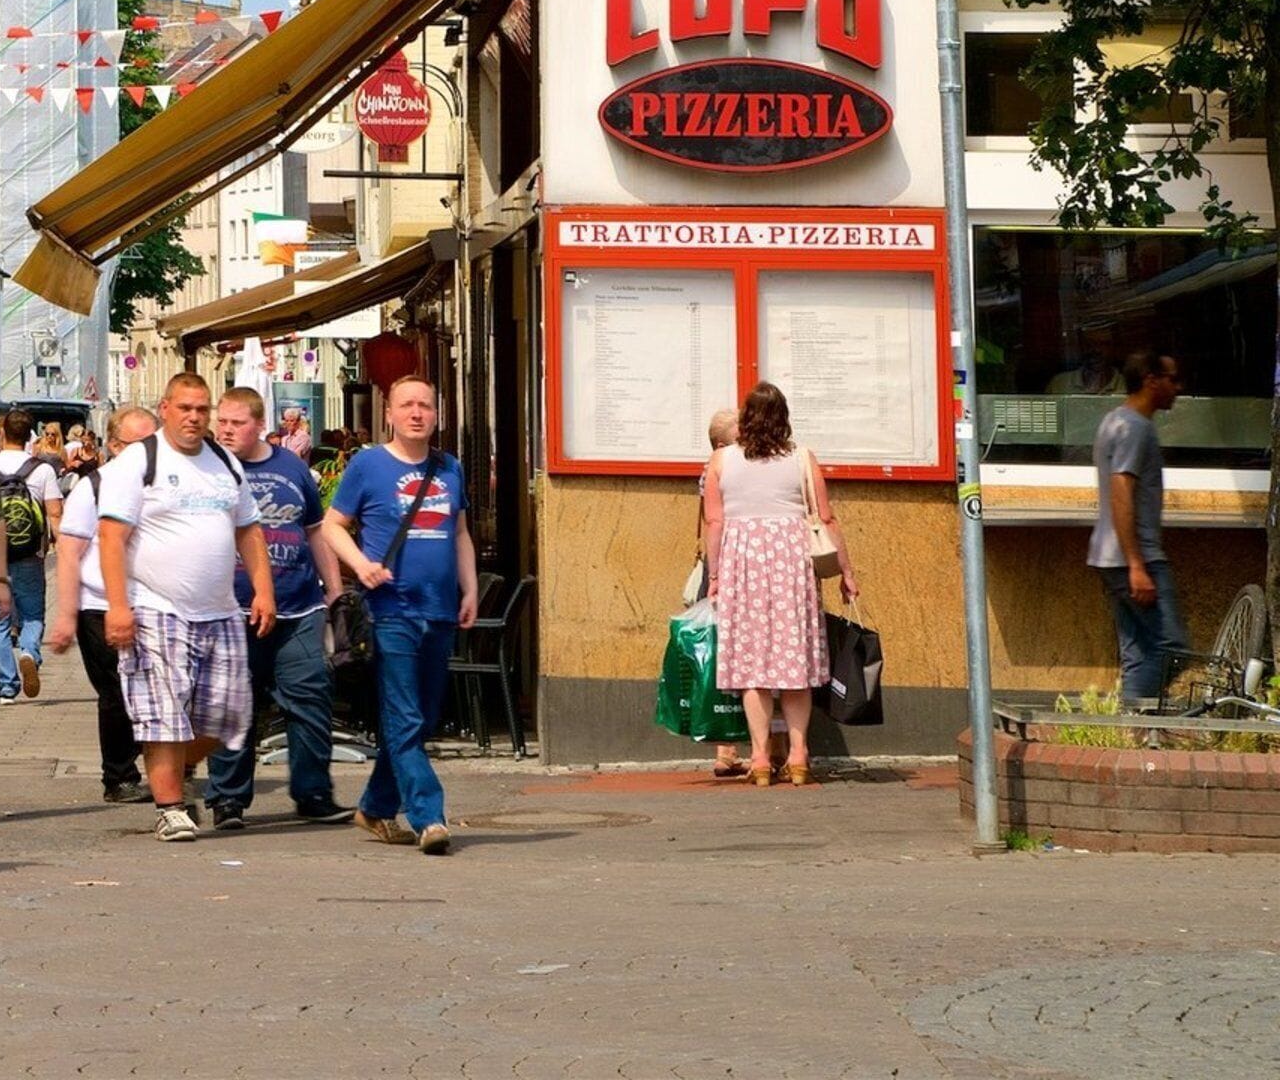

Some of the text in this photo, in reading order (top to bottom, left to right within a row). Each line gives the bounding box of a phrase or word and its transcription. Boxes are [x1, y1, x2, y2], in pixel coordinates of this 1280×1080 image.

[359, 115, 428, 126] Schnellrestaurant
[629, 93, 865, 138] PIZZERIA
[303, 131, 336, 143] eorg
[571, 224, 923, 246] TRATTORIA PIZZERIA
